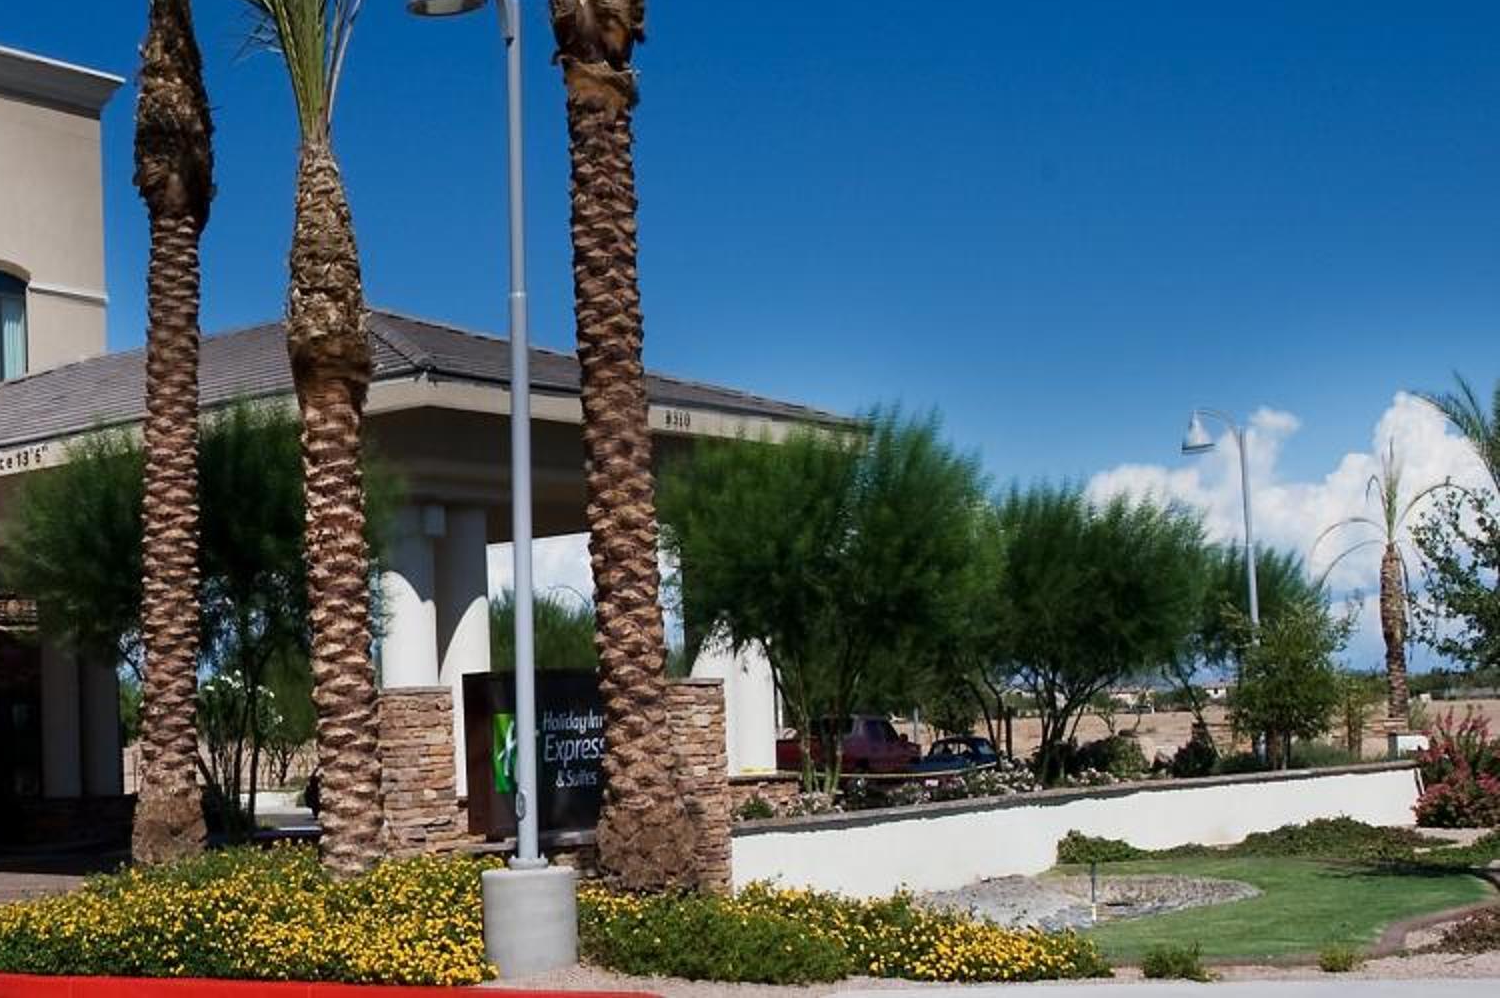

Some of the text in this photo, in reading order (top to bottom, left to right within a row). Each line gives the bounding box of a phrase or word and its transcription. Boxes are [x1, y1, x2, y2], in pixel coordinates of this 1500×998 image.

[543, 711, 587, 734] Holiday
[556, 769, 597, 788] & Suites
